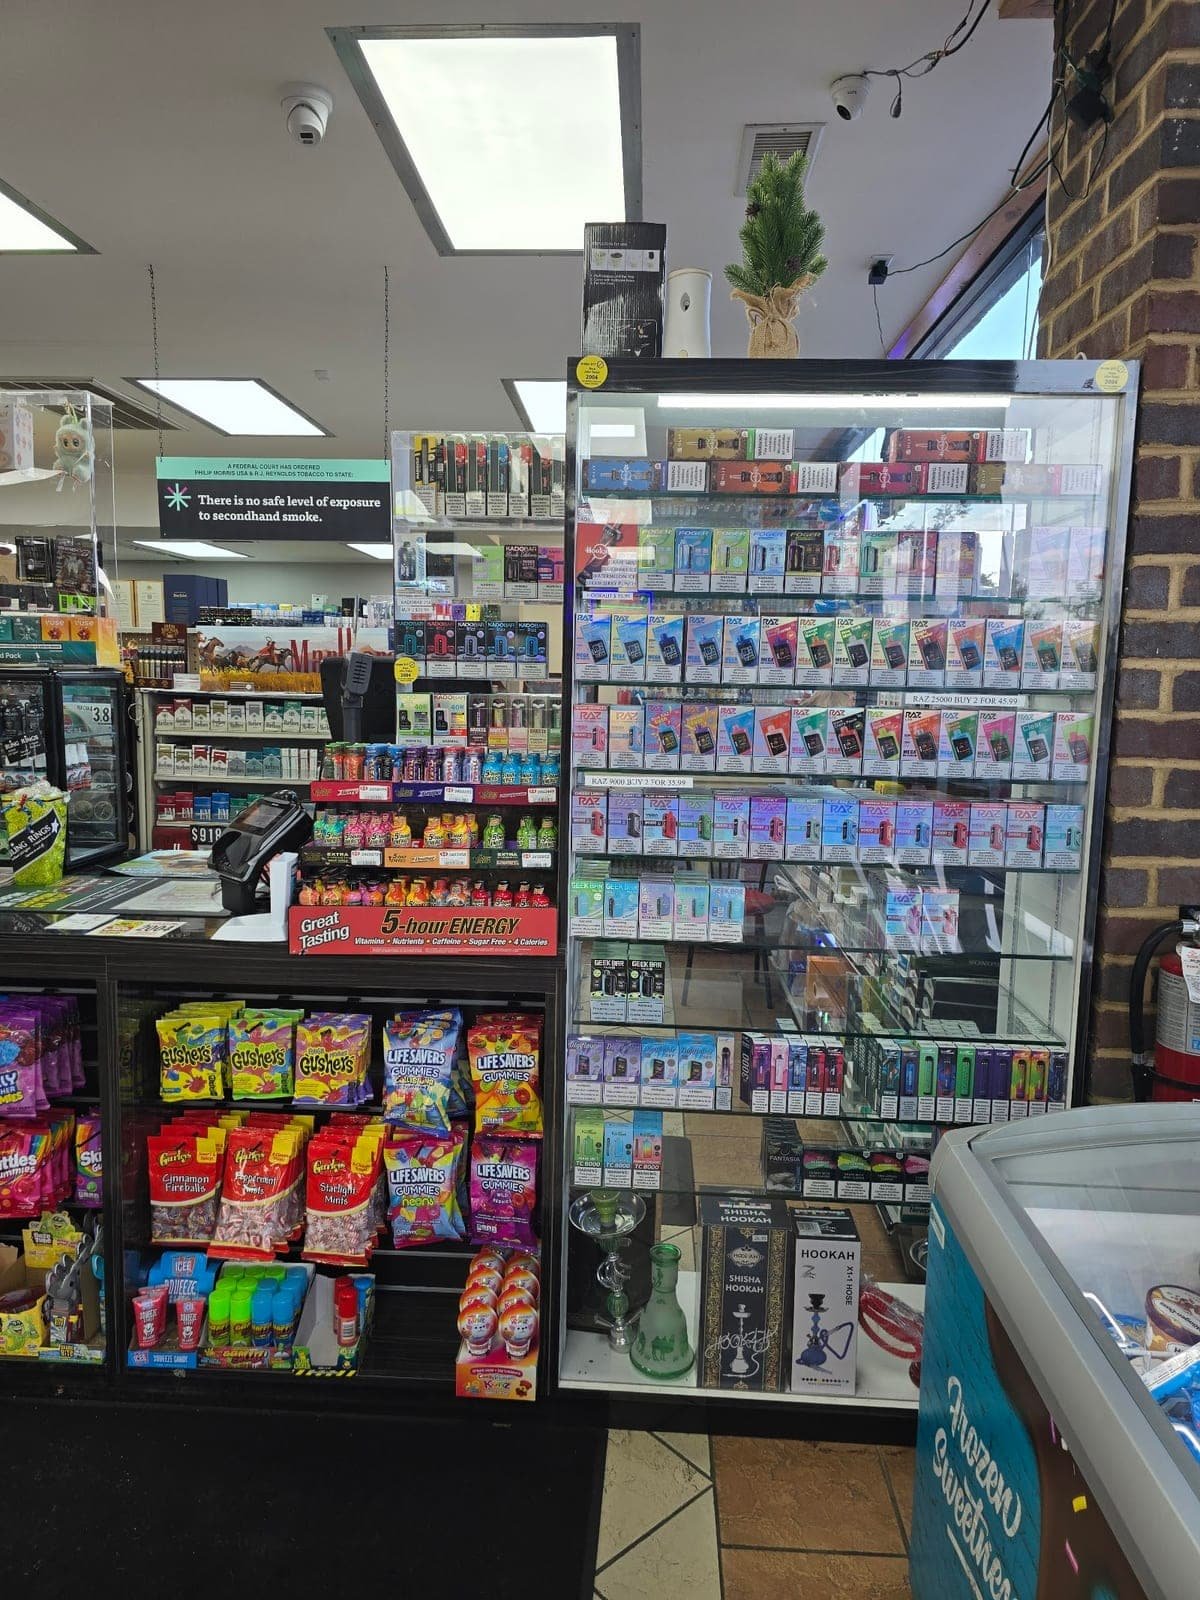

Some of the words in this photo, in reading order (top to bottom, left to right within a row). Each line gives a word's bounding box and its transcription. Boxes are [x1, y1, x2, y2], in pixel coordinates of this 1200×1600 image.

[198, 494, 231, 505] There
[234, 494, 244, 506] is
[246, 497, 260, 506] no
[262, 496, 286, 506] safe
[287, 496, 314, 507] level
[316, 496, 330, 507] of
[330, 498, 382, 510] exposure
[198, 511, 211, 521] to
[212, 510, 281, 522] secondhand
[282, 511, 322, 522] smoke.
[762, 618, 779, 626] RAZ
[837, 618, 854, 626] RAZ
[912, 620, 928, 628] RAZ
[6, 652, 22, 660] Pack
[578, 797, 600, 806] RAZ
[29, 824, 52, 842] RINGS
[301, 911, 340, 933] Great
[381, 910, 448, 935] 5-hour
[448, 918, 520, 935] ENERGY
[299, 926, 350, 950] Tasting
[432, 938, 461, 946] Caffeine
[469, 938, 490, 947] Sugar
[161, 1045, 211, 1068] Gushers
[231, 1048, 285, 1070] Gushers
[300, 1054, 354, 1076] Gushers
[392, 1066, 440, 1078] GUMMIES
[482, 1071, 530, 1083] GUMMIES
[0, 1072, 18, 1088] LLY
[162, 1174, 210, 1184] Cinnamon
[235, 1171, 276, 1185] Peppermint
[165, 1183, 206, 1193] Fireballs
[320, 1183, 357, 1197] Starlight
[395, 1185, 441, 1197] GUMMIES
[482, 1180, 525, 1194] GUMMIES
[324, 1196, 348, 1205] Mints
[402, 1196, 434, 1207] neons
[724, 1208, 767, 1217] SHISHA
[721, 1216, 772, 1225] HOOKAH
[801, 1249, 855, 1260] HOOKAH
[174, 1260, 191, 1272] ICEE
[729, 1275, 761, 1284] SHISHA
[725, 1284, 764, 1294] HOOKAH
[948, 1375, 1022, 1538] Frozen
